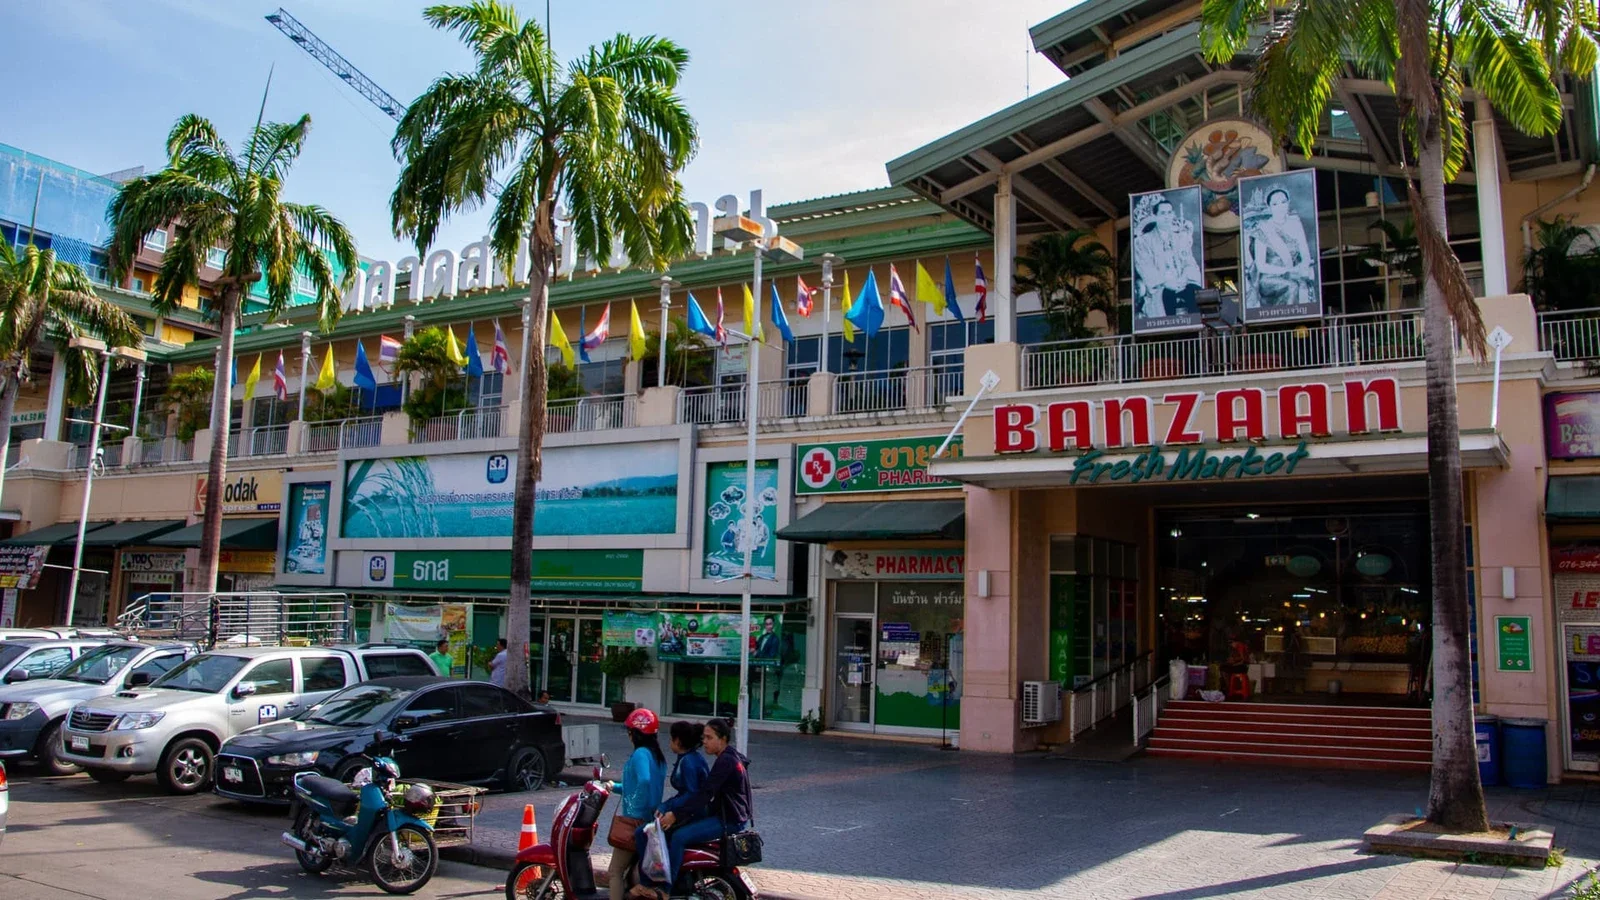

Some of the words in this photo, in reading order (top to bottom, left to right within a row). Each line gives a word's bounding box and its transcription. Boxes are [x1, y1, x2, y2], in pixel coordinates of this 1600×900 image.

[993, 377, 1402, 453] BANZAAN
[1069, 445, 1166, 484] Fresh
[1166, 441, 1310, 481] Market
[223, 477, 259, 503] odak
[413, 558, 449, 582] ธกส
[876, 556, 965, 574] PHARMACY
